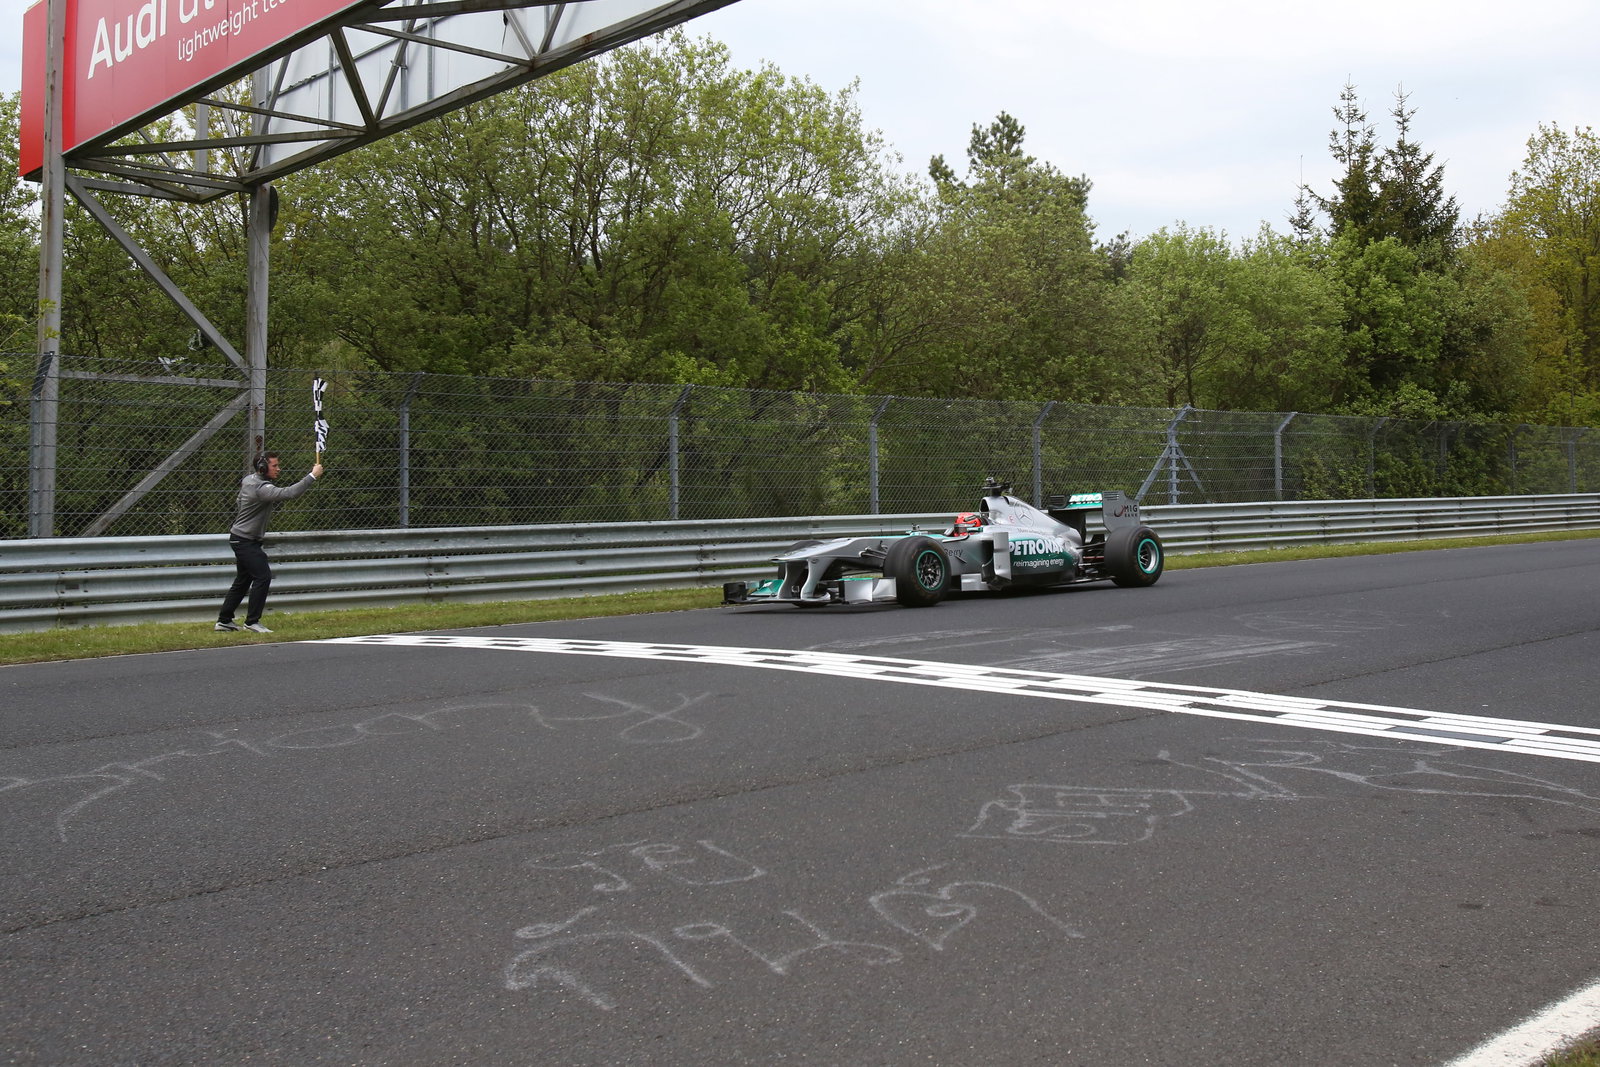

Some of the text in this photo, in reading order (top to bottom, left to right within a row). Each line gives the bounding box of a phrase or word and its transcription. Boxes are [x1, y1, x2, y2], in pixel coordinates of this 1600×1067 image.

[87, 0, 166, 80] Audi
[178, 0, 259, 62] lightweight
[1124, 505, 1138, 513] MIG
[1013, 559, 1065, 569] reimagining energy
